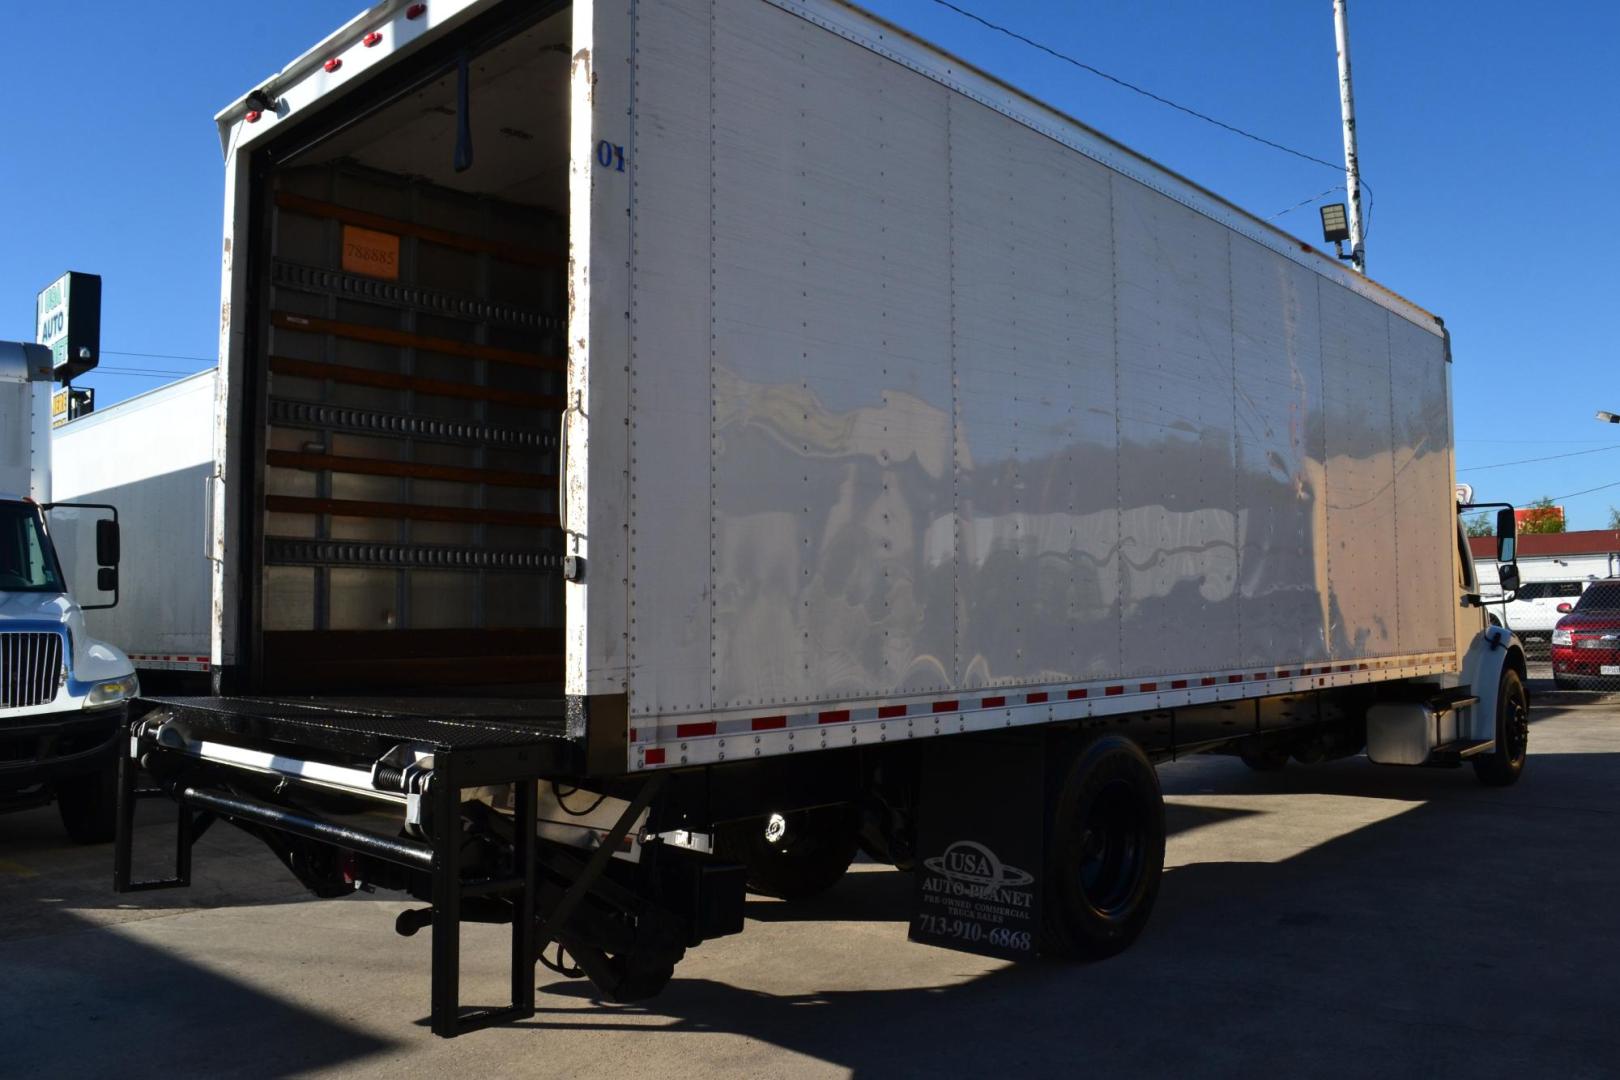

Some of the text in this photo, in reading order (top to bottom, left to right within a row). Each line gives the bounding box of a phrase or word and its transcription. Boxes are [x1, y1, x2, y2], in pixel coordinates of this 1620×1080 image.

[597, 139, 625, 173] 01
[42, 312, 64, 343] AUTO
[949, 852, 991, 876] USA
[923, 895, 1031, 920] PRE-OWNED COMMERCIAL
[948, 907, 1004, 924] TRUCK SALES
[919, 914, 1031, 951] 713-910-6868
